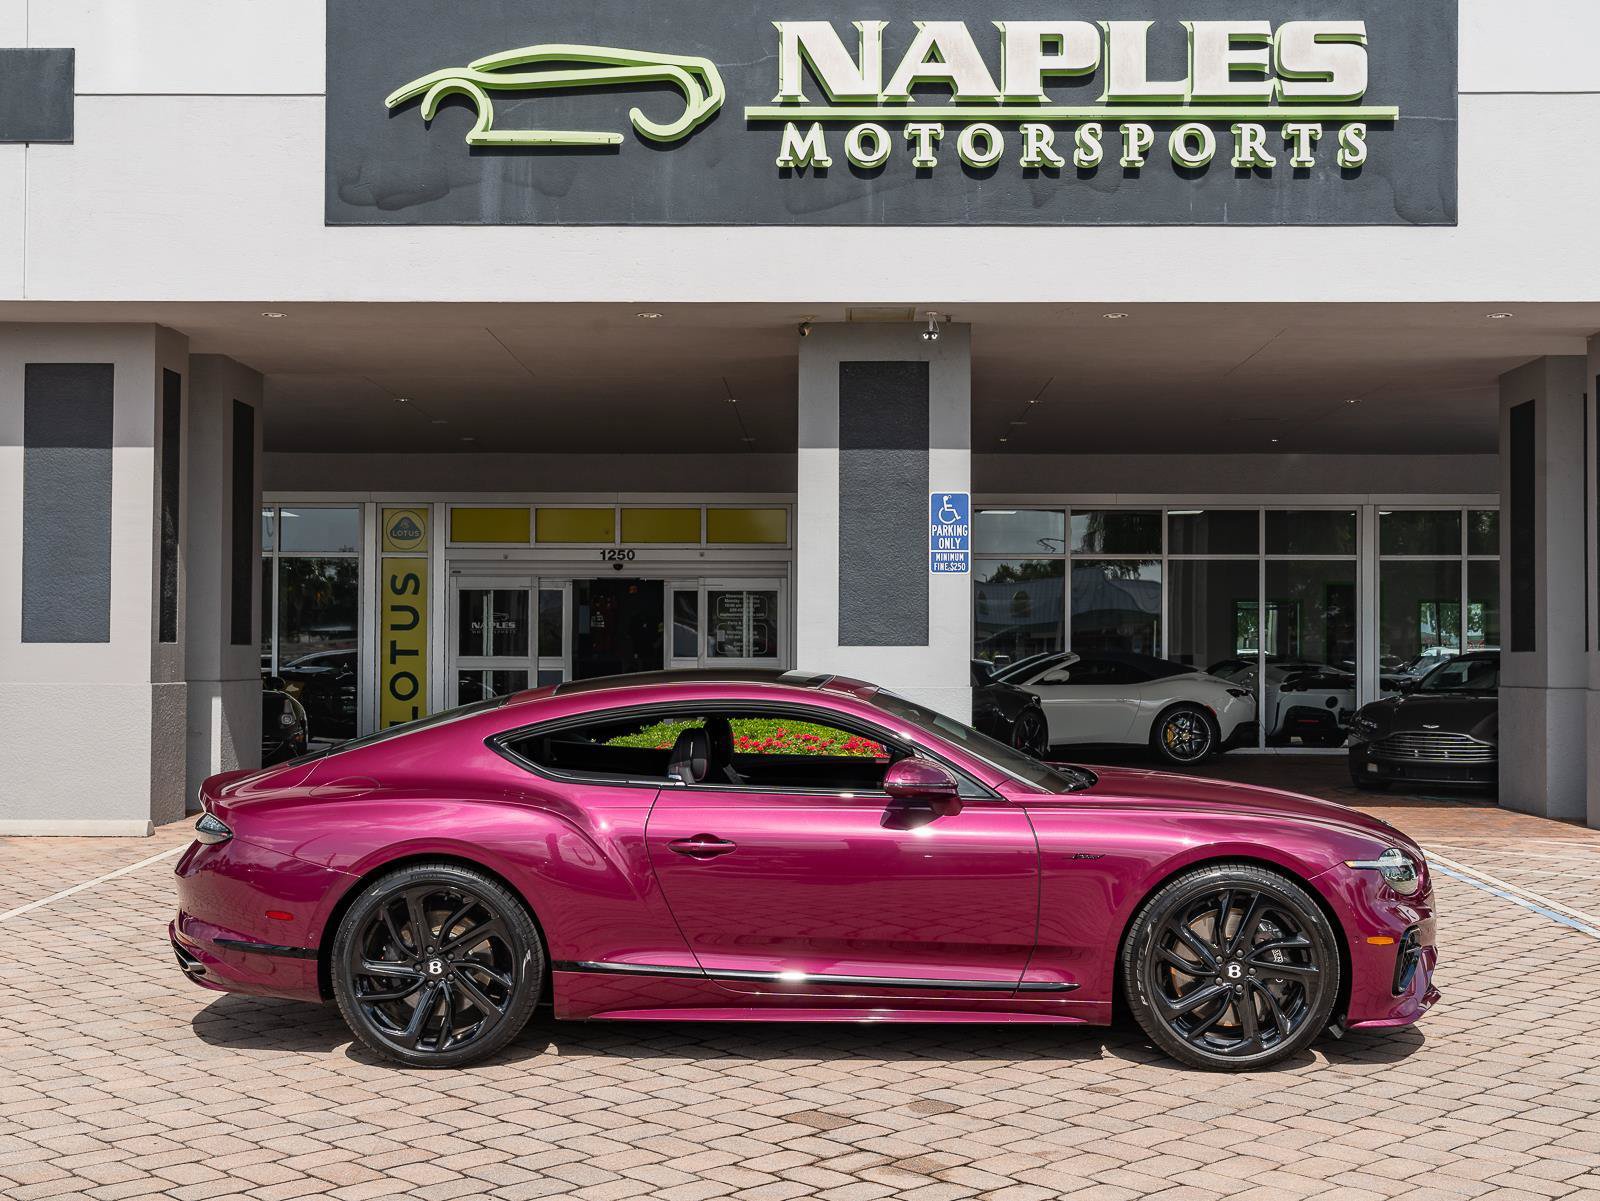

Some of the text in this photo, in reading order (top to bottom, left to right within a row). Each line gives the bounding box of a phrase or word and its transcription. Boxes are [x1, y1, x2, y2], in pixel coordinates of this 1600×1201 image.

[771, 20, 1368, 103] NAPLES
[775, 121, 1368, 168] MOTORSPORTS
[391, 529, 421, 537] LOTUS
[931, 524, 968, 537] PARKING
[938, 537, 961, 550] ONLY
[600, 549, 636, 561] 1250
[935, 552, 964, 562] MINIMUM
[933, 561, 966, 572] FINE $250
[429, 960, 443, 975] B
[1227, 964, 1242, 979] B
